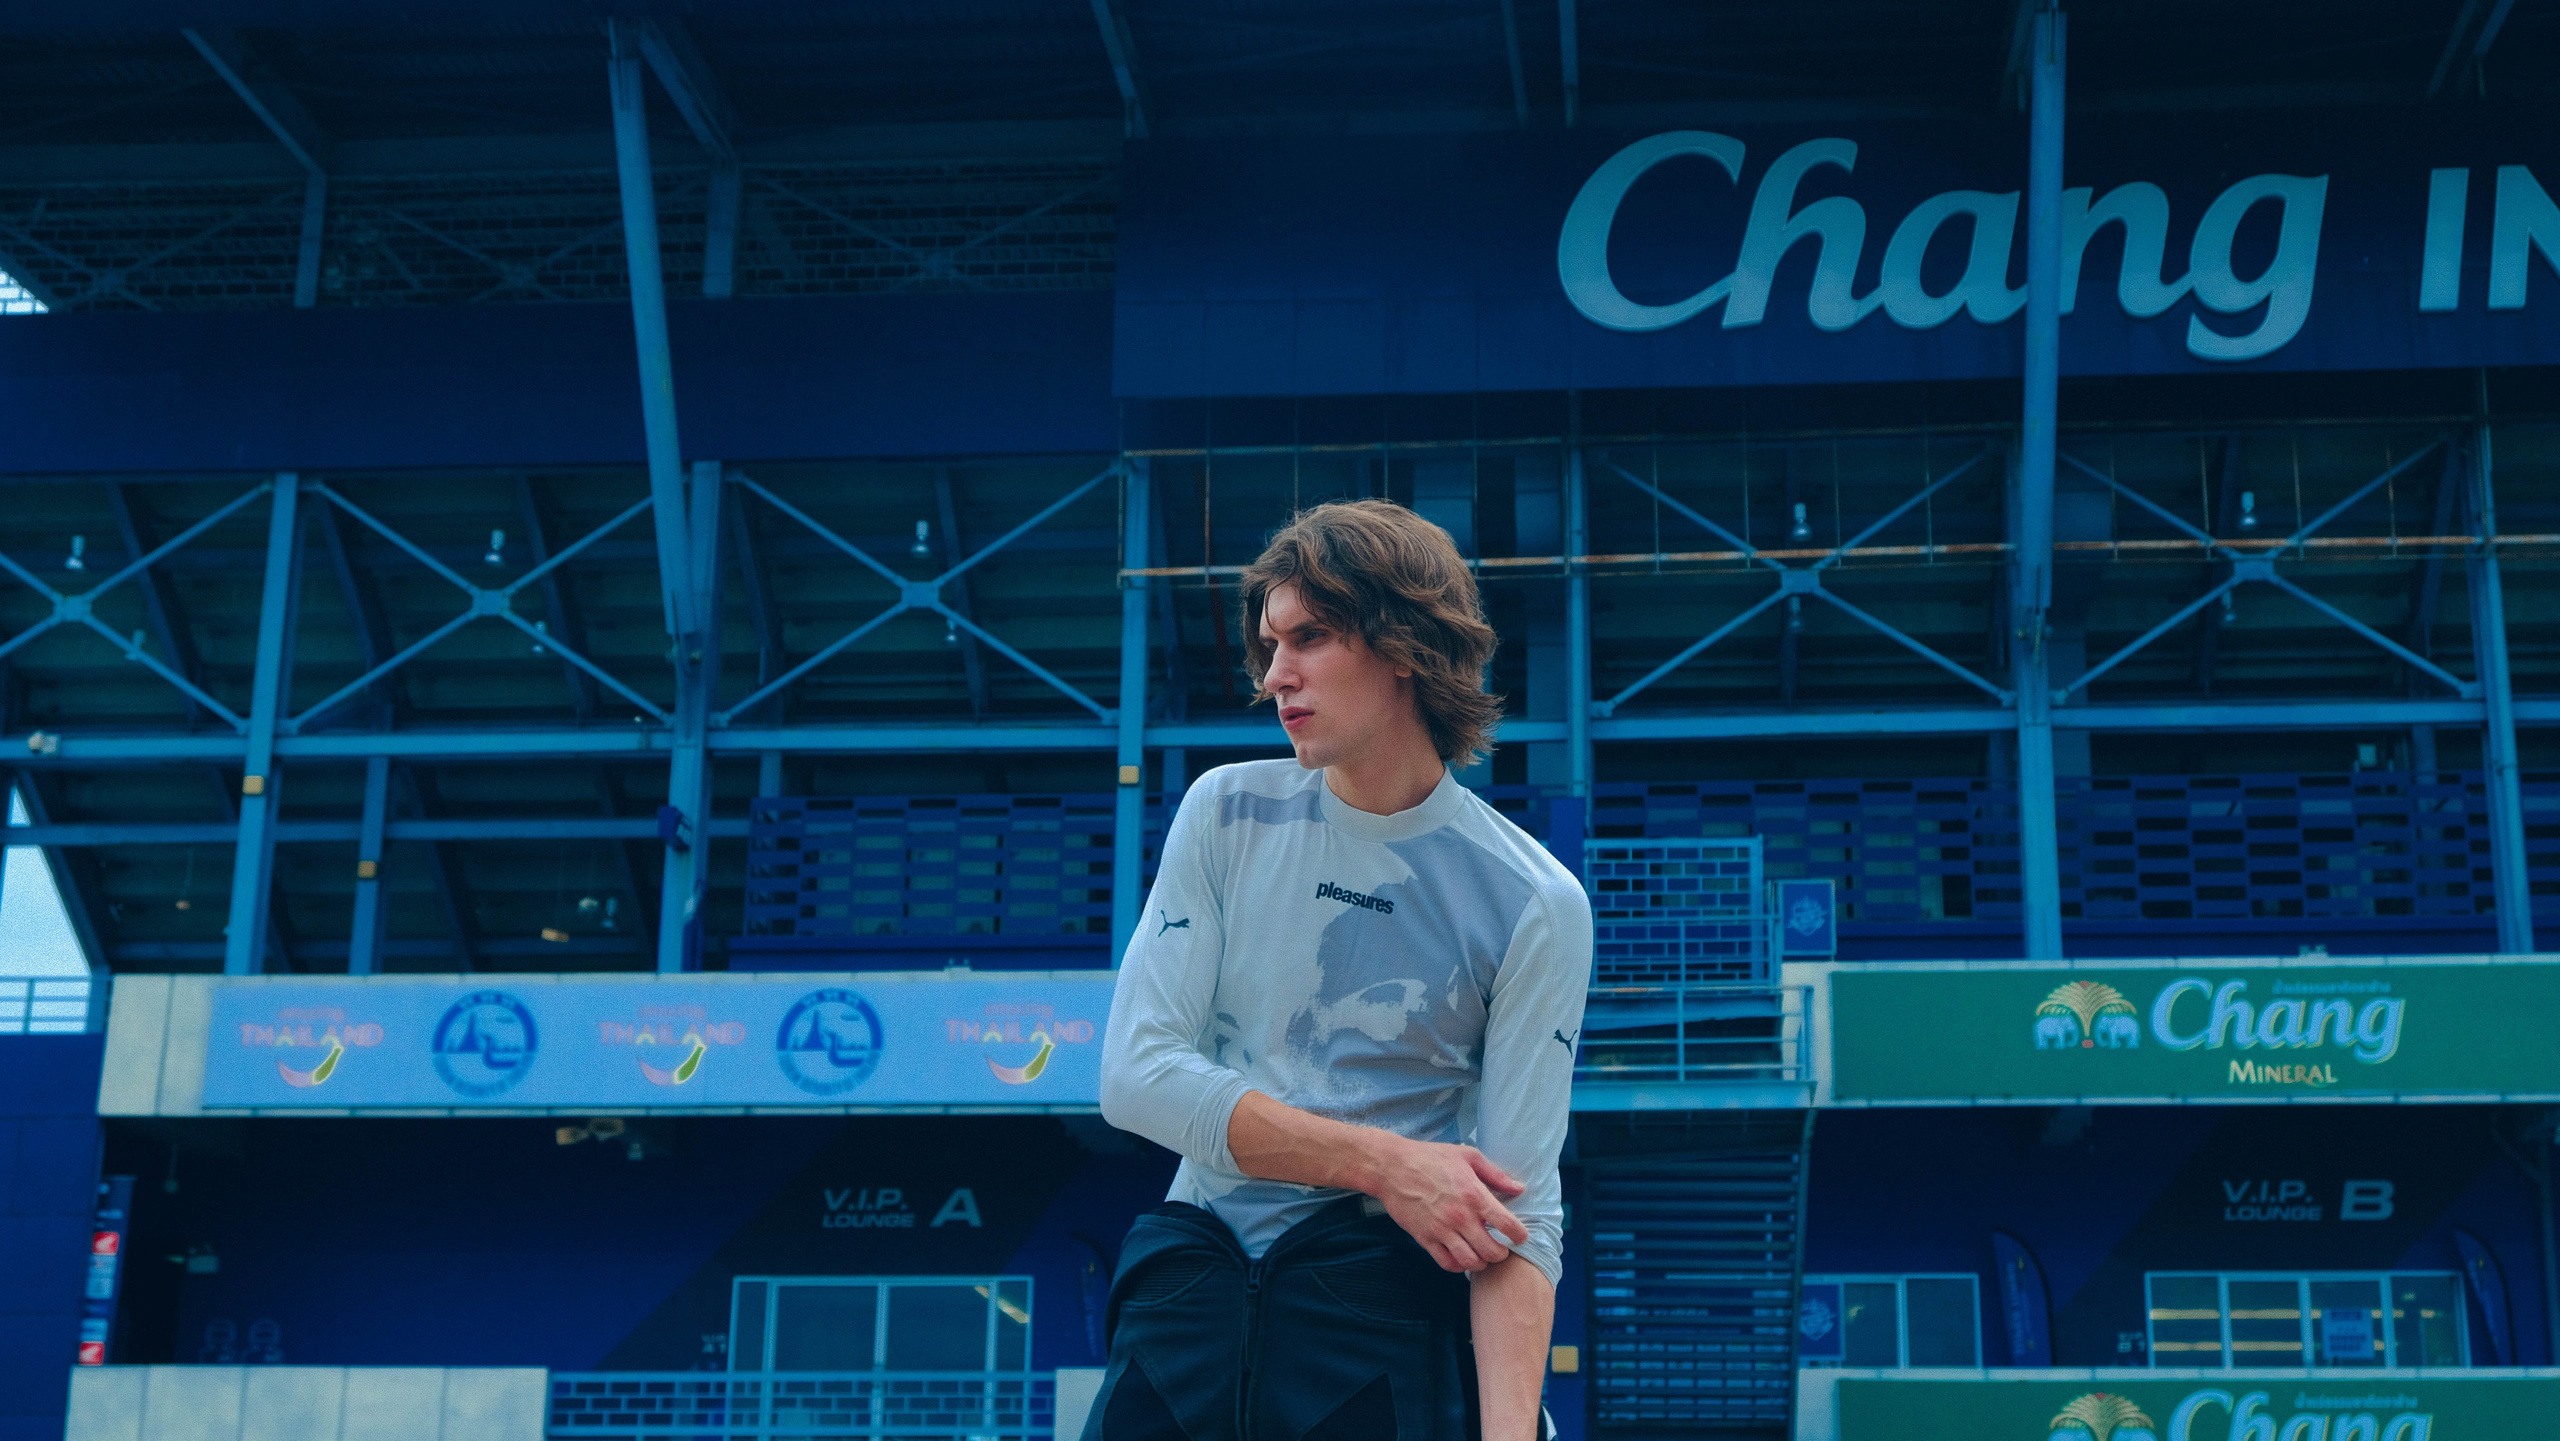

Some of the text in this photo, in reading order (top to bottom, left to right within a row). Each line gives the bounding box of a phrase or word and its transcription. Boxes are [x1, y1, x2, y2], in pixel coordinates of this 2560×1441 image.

[1556, 128, 2329, 361] Chang
[1315, 881, 1395, 915] pleasures
[944, 1020, 1095, 1043] THAILAND
[2150, 976, 2406, 1064] Chang
[240, 1023, 384, 1047] THAILAND
[597, 1021, 747, 1045] THAILAND
[823, 1187, 909, 1211] V.I.P.
[2222, 1179, 2313, 1204] V.I.P.
[2339, 1179, 2395, 1222] B
[929, 1187, 983, 1228] A
[2224, 1205, 2323, 1222] LOUNGE
[822, 1212, 916, 1228] LOUNGE
